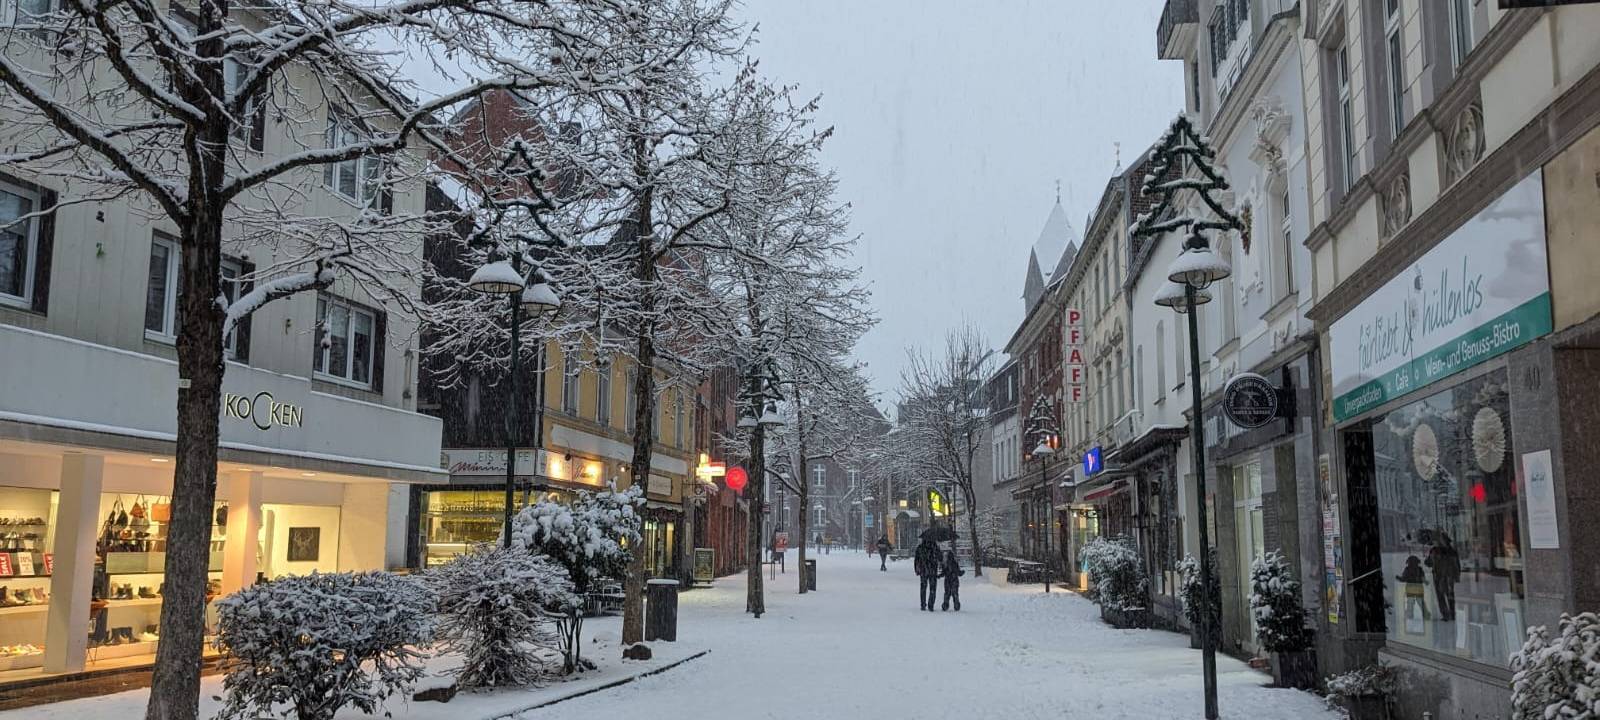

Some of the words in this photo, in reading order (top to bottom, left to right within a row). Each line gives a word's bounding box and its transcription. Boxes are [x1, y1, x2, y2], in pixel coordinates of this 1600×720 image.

[1422, 255, 1483, 337] hüllenlos
[1069, 311, 1082, 402] PFAFF
[1425, 354, 1446, 377] Wein-
[1446, 343, 1461, 369] und
[1461, 322, 1520, 361] Genuss-Bistro
[224, 391, 303, 430] KOCKEN
[478, 452, 494, 462] EIS
[502, 452, 530, 462] CFE
